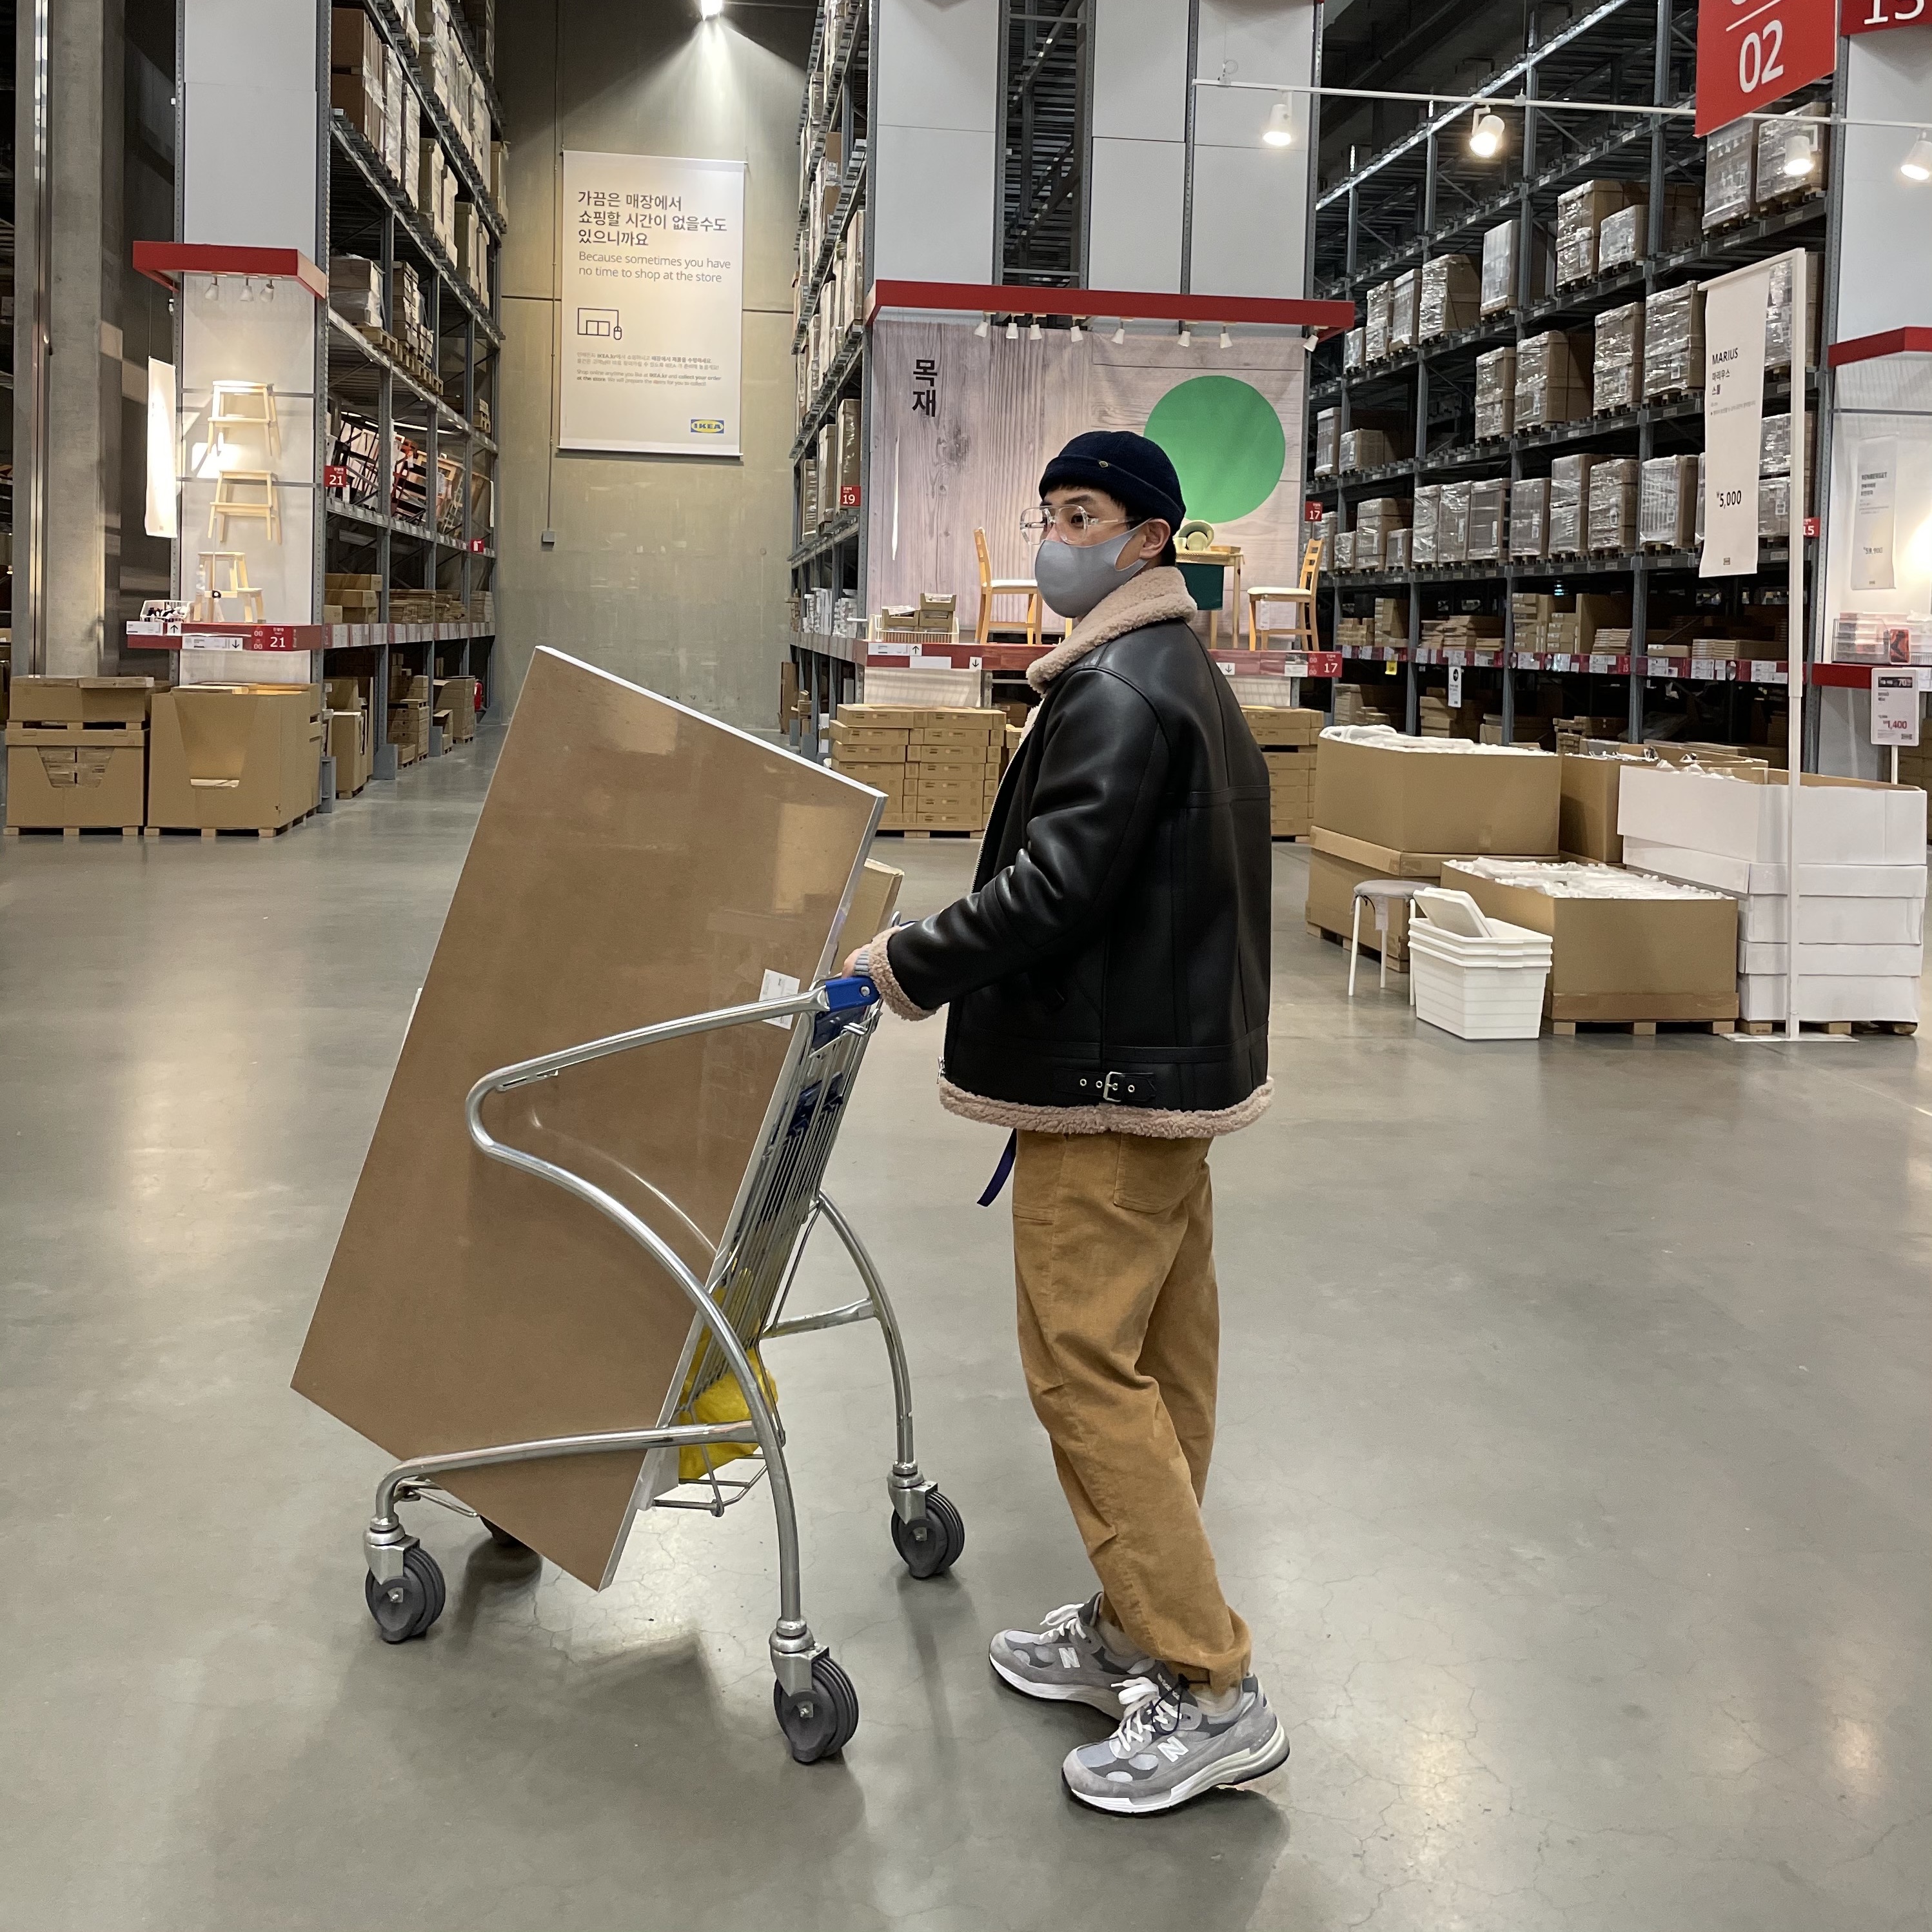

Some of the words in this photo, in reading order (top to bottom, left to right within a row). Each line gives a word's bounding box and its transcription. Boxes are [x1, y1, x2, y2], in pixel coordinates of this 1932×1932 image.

[1739, 19, 1784, 94] 02
[578, 190, 621, 208] 가끔은
[626, 193, 682, 212] 매장에서
[578, 210, 621, 227] 쇼핑할
[625, 212, 667, 230] 시간이
[672, 215, 727, 232] 없을수도
[578, 229, 649, 246] 있으니까요
[578, 251, 622, 263] Because
[625, 255, 682, 266] sometimes
[684, 259, 704, 270] you
[706, 257, 731, 269] have
[578, 267, 593, 276] no
[595, 266, 619, 277] time
[622, 268, 633, 278] to
[635, 268, 661, 282] shop
[663, 271, 674, 280] at
[676, 270, 693, 281] the
[695, 272, 722, 283] store
[1711, 347, 1739, 365] MARIUS
[912, 359, 938, 418] 목재
[329, 474, 344, 486] 21
[842, 494, 856, 504] 19
[1310, 510, 1321, 520] 17
[270, 636, 286, 648] 21
[1324, 662, 1338, 673] 17
[1059, 1647, 1081, 1669] N
[1157, 1736, 1190, 1764] N
